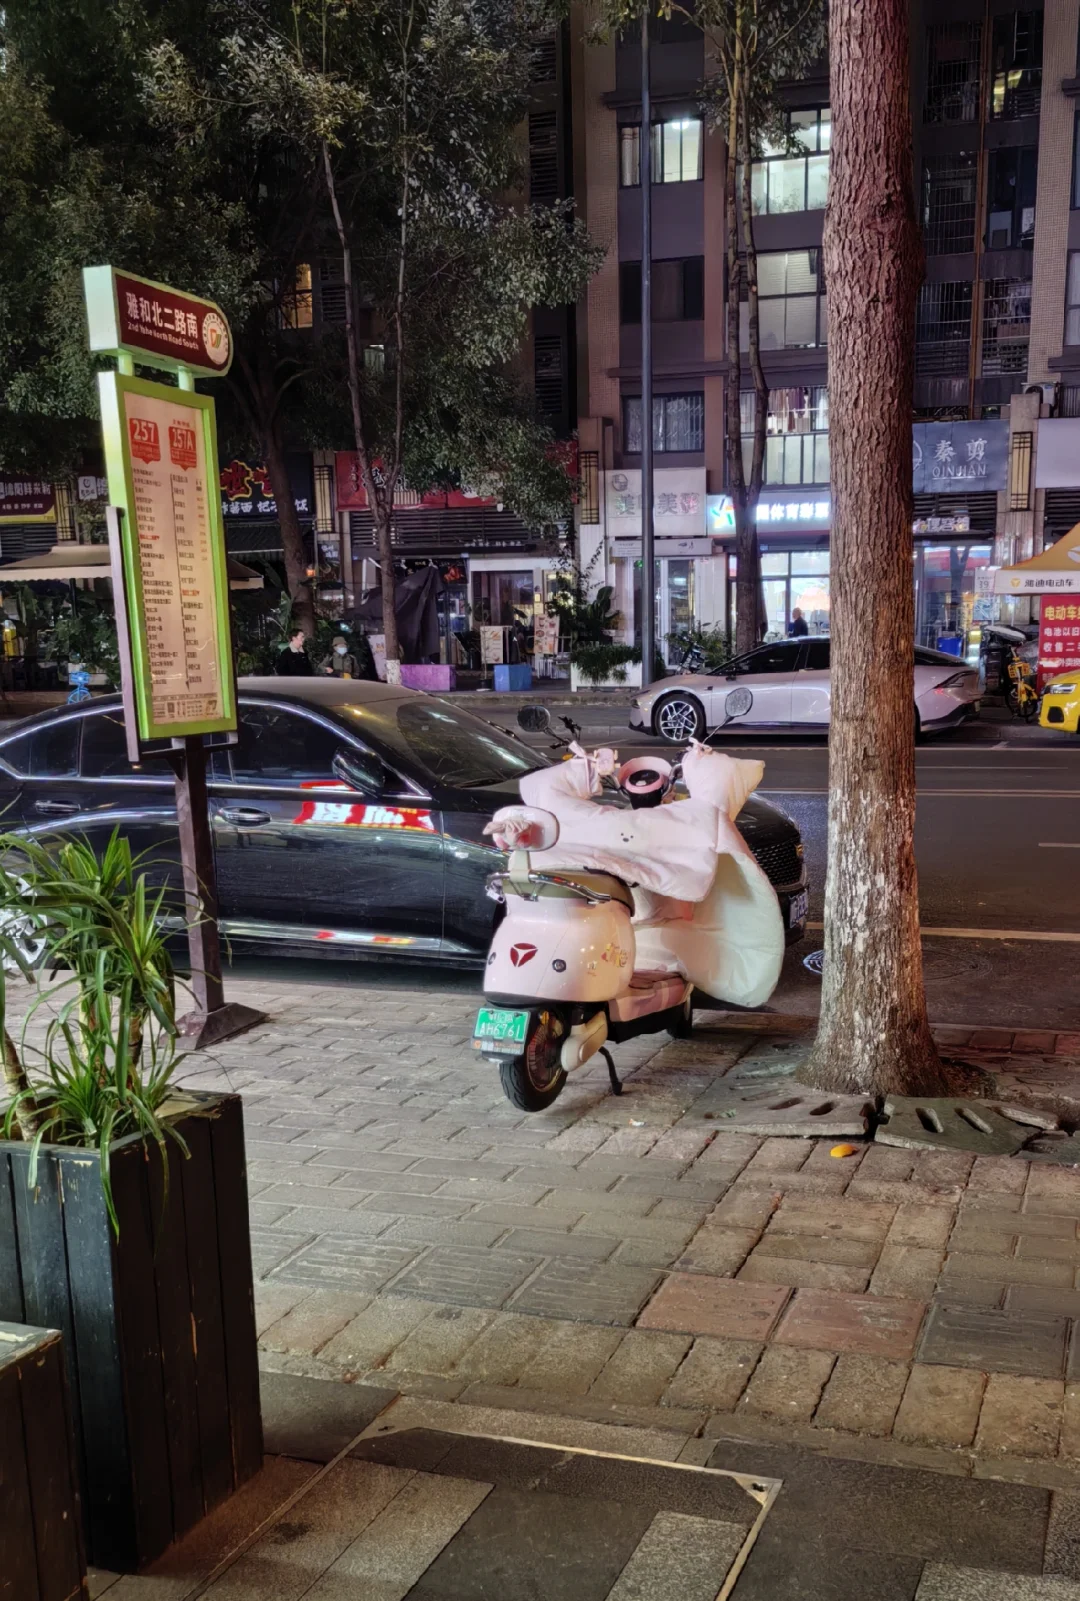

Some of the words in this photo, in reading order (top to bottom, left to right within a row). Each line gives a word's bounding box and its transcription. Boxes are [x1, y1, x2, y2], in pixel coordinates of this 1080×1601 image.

[125, 292, 198, 339] 雅和北二路南
[128, 321, 139, 332] 2nd
[153, 329, 168, 341] North
[168, 333, 183, 346] Road
[182, 338, 199, 350] South
[132, 419, 155, 443] 257
[171, 428, 194, 451] 257A
[934, 438, 987, 462] 秦剪
[932, 463, 987, 477] QINJIAN
[479, 1022, 521, 1038] AH6761
